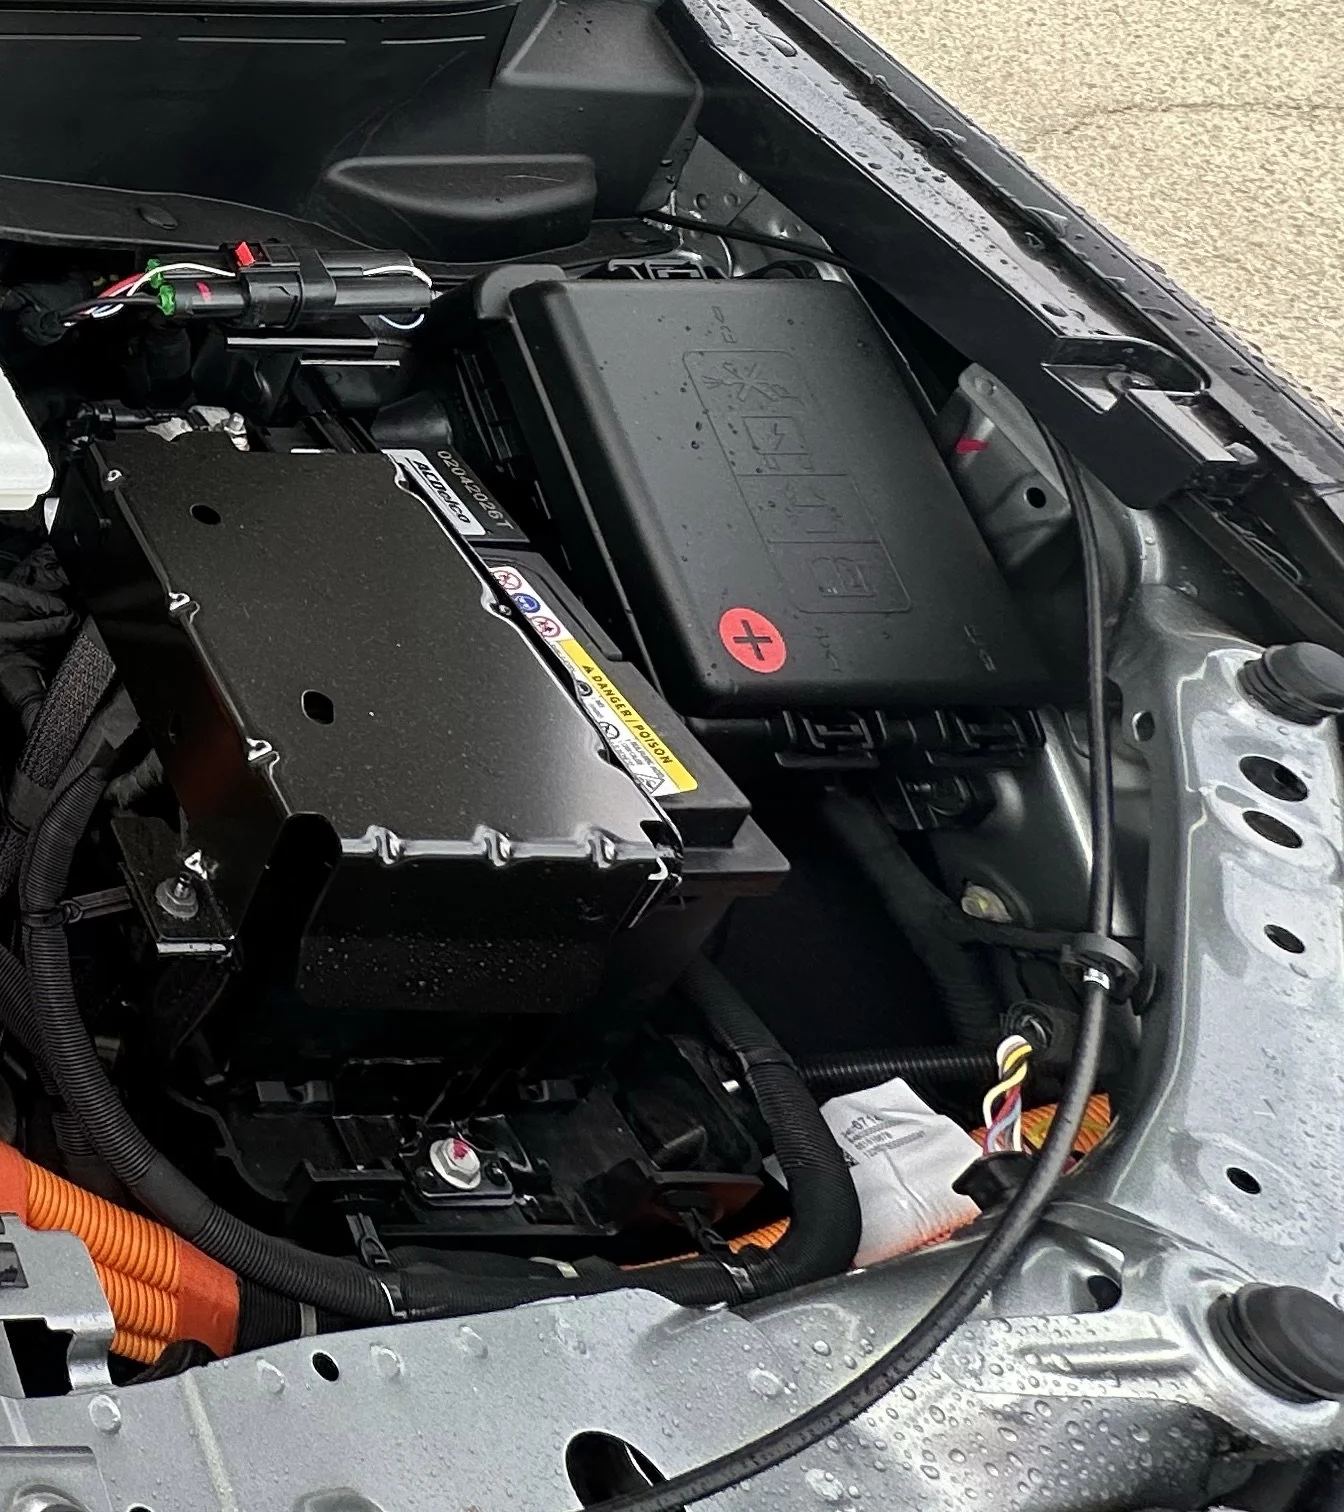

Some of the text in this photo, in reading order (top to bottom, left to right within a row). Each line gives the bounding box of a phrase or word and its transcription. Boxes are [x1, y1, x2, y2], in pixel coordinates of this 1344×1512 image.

[413, 459, 471, 523] ACDelco
[437, 450, 514, 530] 02042026T
[592, 675, 632, 719] DANGER
[633, 724, 673, 765] POISON
